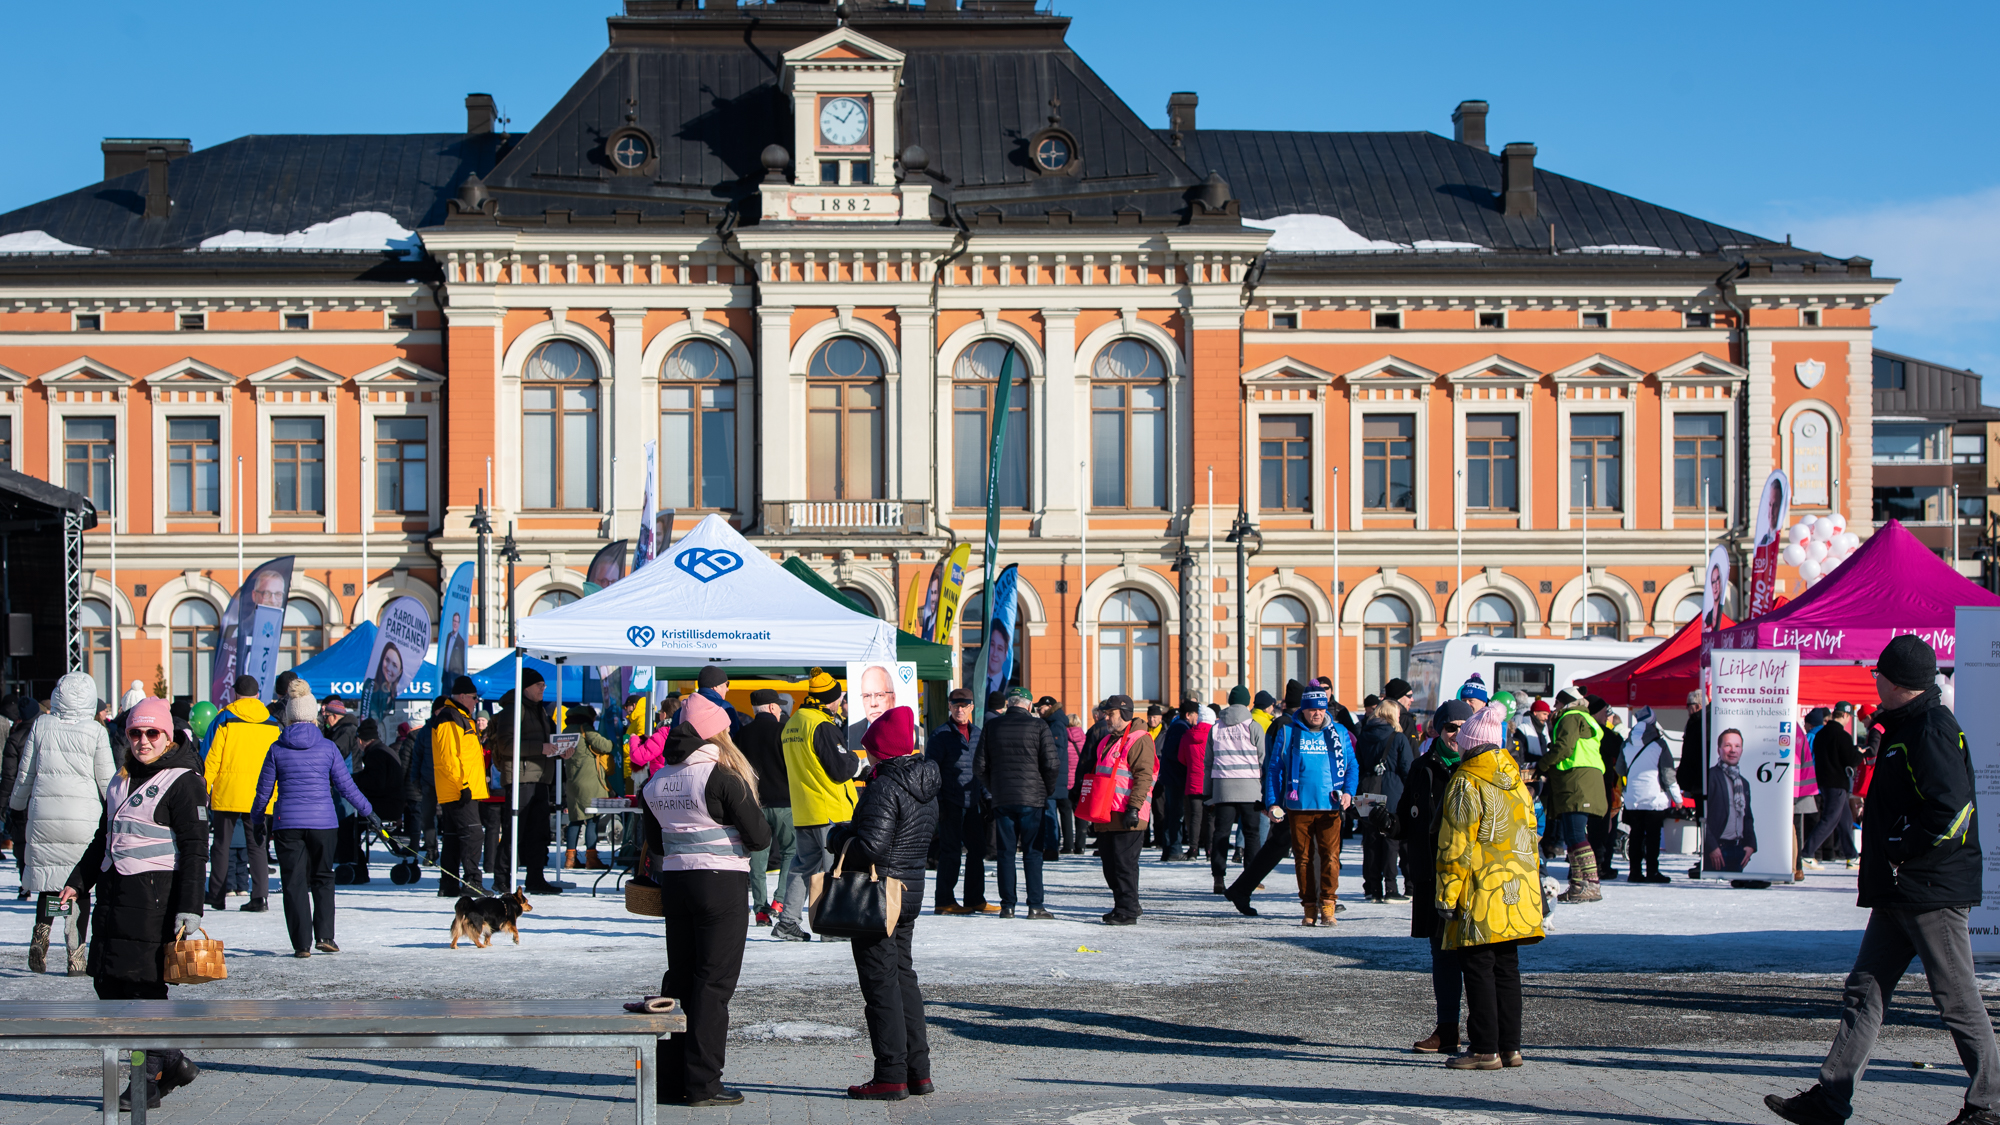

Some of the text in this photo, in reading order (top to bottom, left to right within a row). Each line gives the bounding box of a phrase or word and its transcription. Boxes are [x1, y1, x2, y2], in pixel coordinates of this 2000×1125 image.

[820, 198, 871, 212] 1882
[393, 607, 427, 637] KAROLIINA
[386, 618, 427, 651] PARTANEN
[661, 629, 771, 640] Kristillisdemokraatit
[661, 640, 718, 649] Pohjois-Savo
[1932, 628, 1955, 655] Ny
[1719, 657, 1790, 684] Liike Nyt
[330, 681, 432, 694] KOKUS
[1716, 685, 1790, 695] Teemu Soini
[1714, 706, 1790, 717] Päätetään yhdessä!
[1756, 761, 1791, 783] 67
[662, 781, 683, 792] AULI
[650, 799, 699, 810] PIIPARINEN
